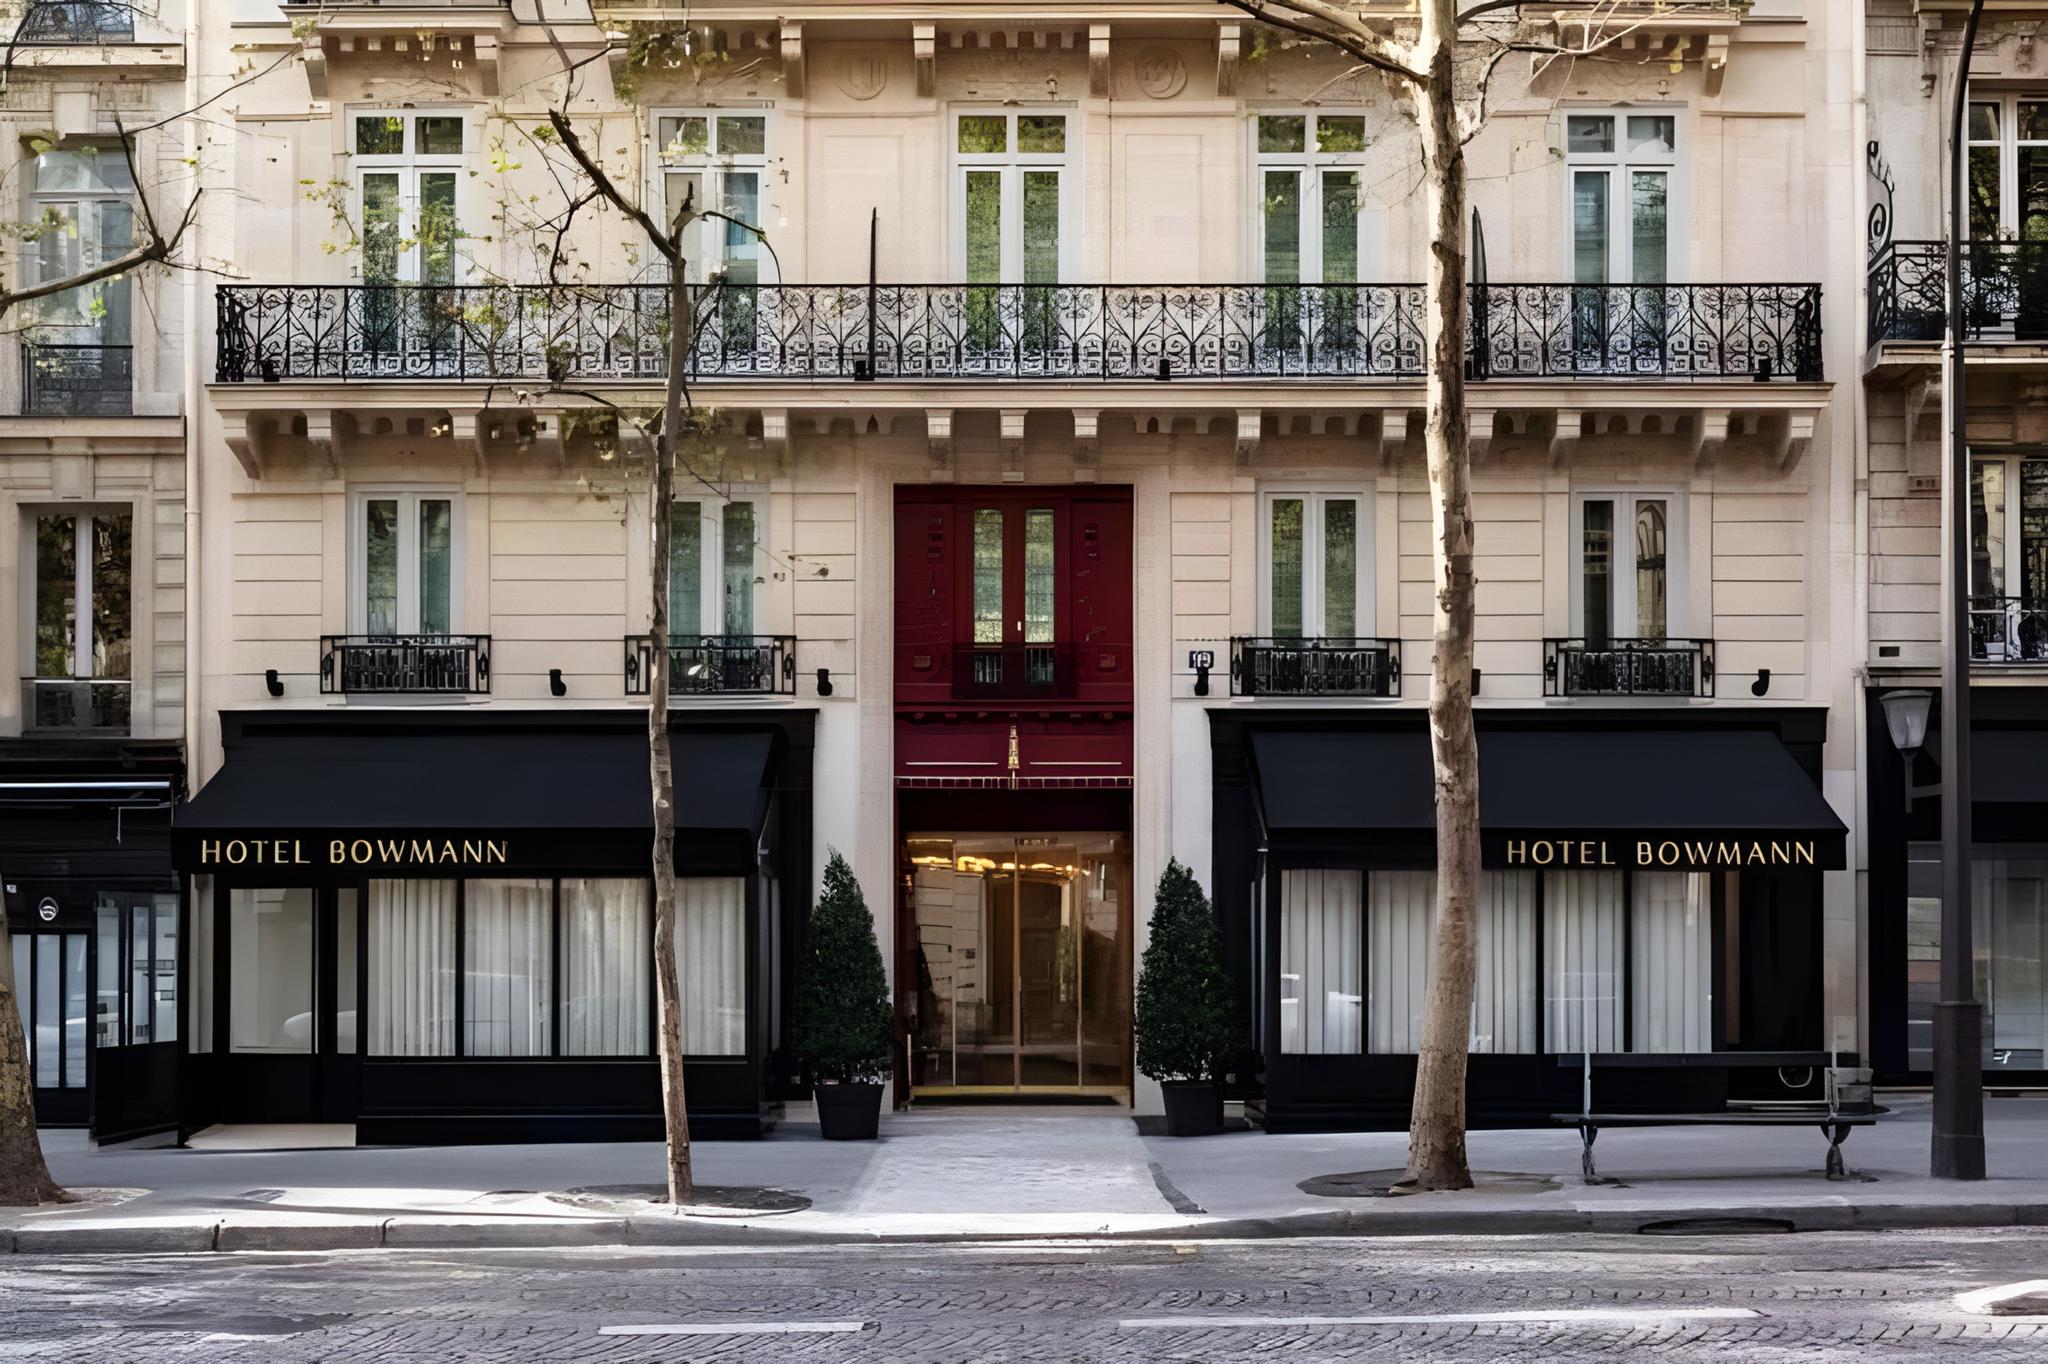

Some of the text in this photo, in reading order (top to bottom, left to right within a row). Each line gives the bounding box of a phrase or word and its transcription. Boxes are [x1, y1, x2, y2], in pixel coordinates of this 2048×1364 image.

[201, 840, 508, 864] HOTEL BOWMANN
[1507, 841, 1815, 865] HOTEL BOWMANN
